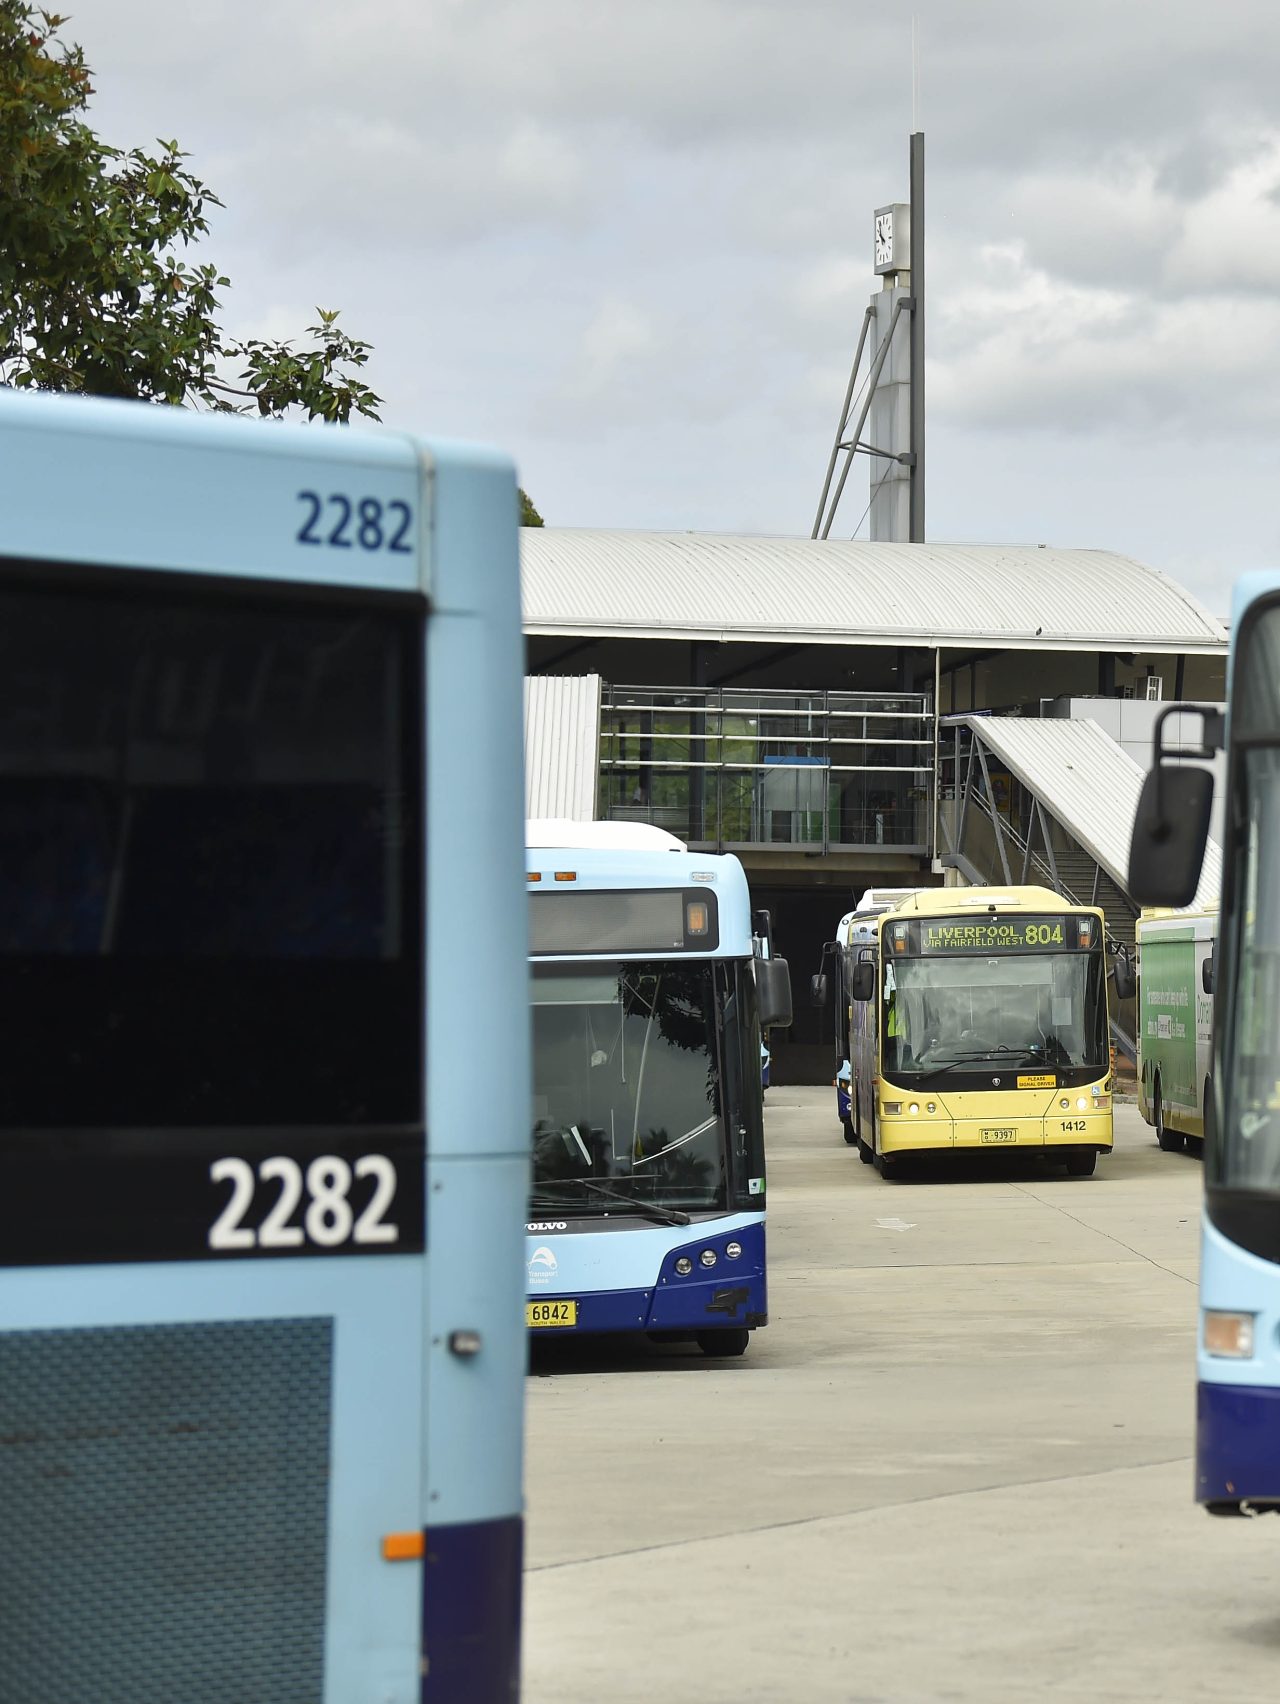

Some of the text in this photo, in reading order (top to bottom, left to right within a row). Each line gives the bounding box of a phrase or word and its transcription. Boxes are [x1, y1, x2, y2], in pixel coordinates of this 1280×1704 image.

[296, 489, 413, 554] 2282
[923, 936, 1024, 948] VIA FAIRFIELD WEST
[928, 924, 1064, 945] LIVERPOOL 804
[1060, 1120, 1086, 1131] 1412
[208, 1153, 398, 1249] 2282
